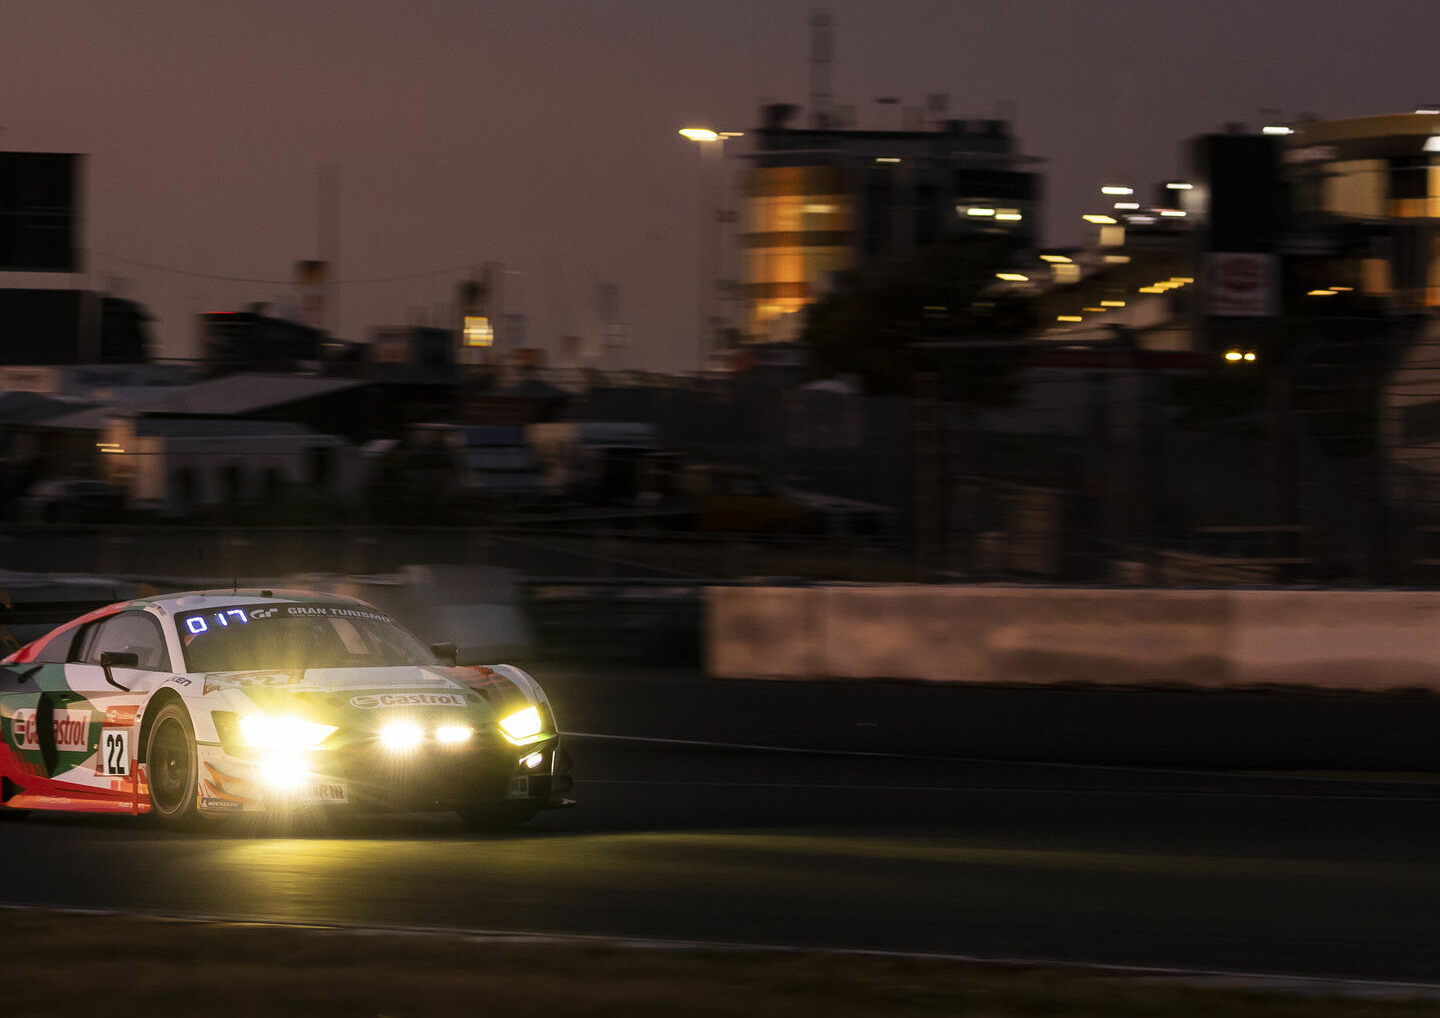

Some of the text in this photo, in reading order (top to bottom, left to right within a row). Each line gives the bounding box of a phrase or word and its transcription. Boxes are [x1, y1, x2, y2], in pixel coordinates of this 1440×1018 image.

[288, 607, 326, 616] GRAN
[330, 608, 390, 622] TURISMO
[379, 694, 462, 705] Castrol
[107, 734, 125, 774] 22
